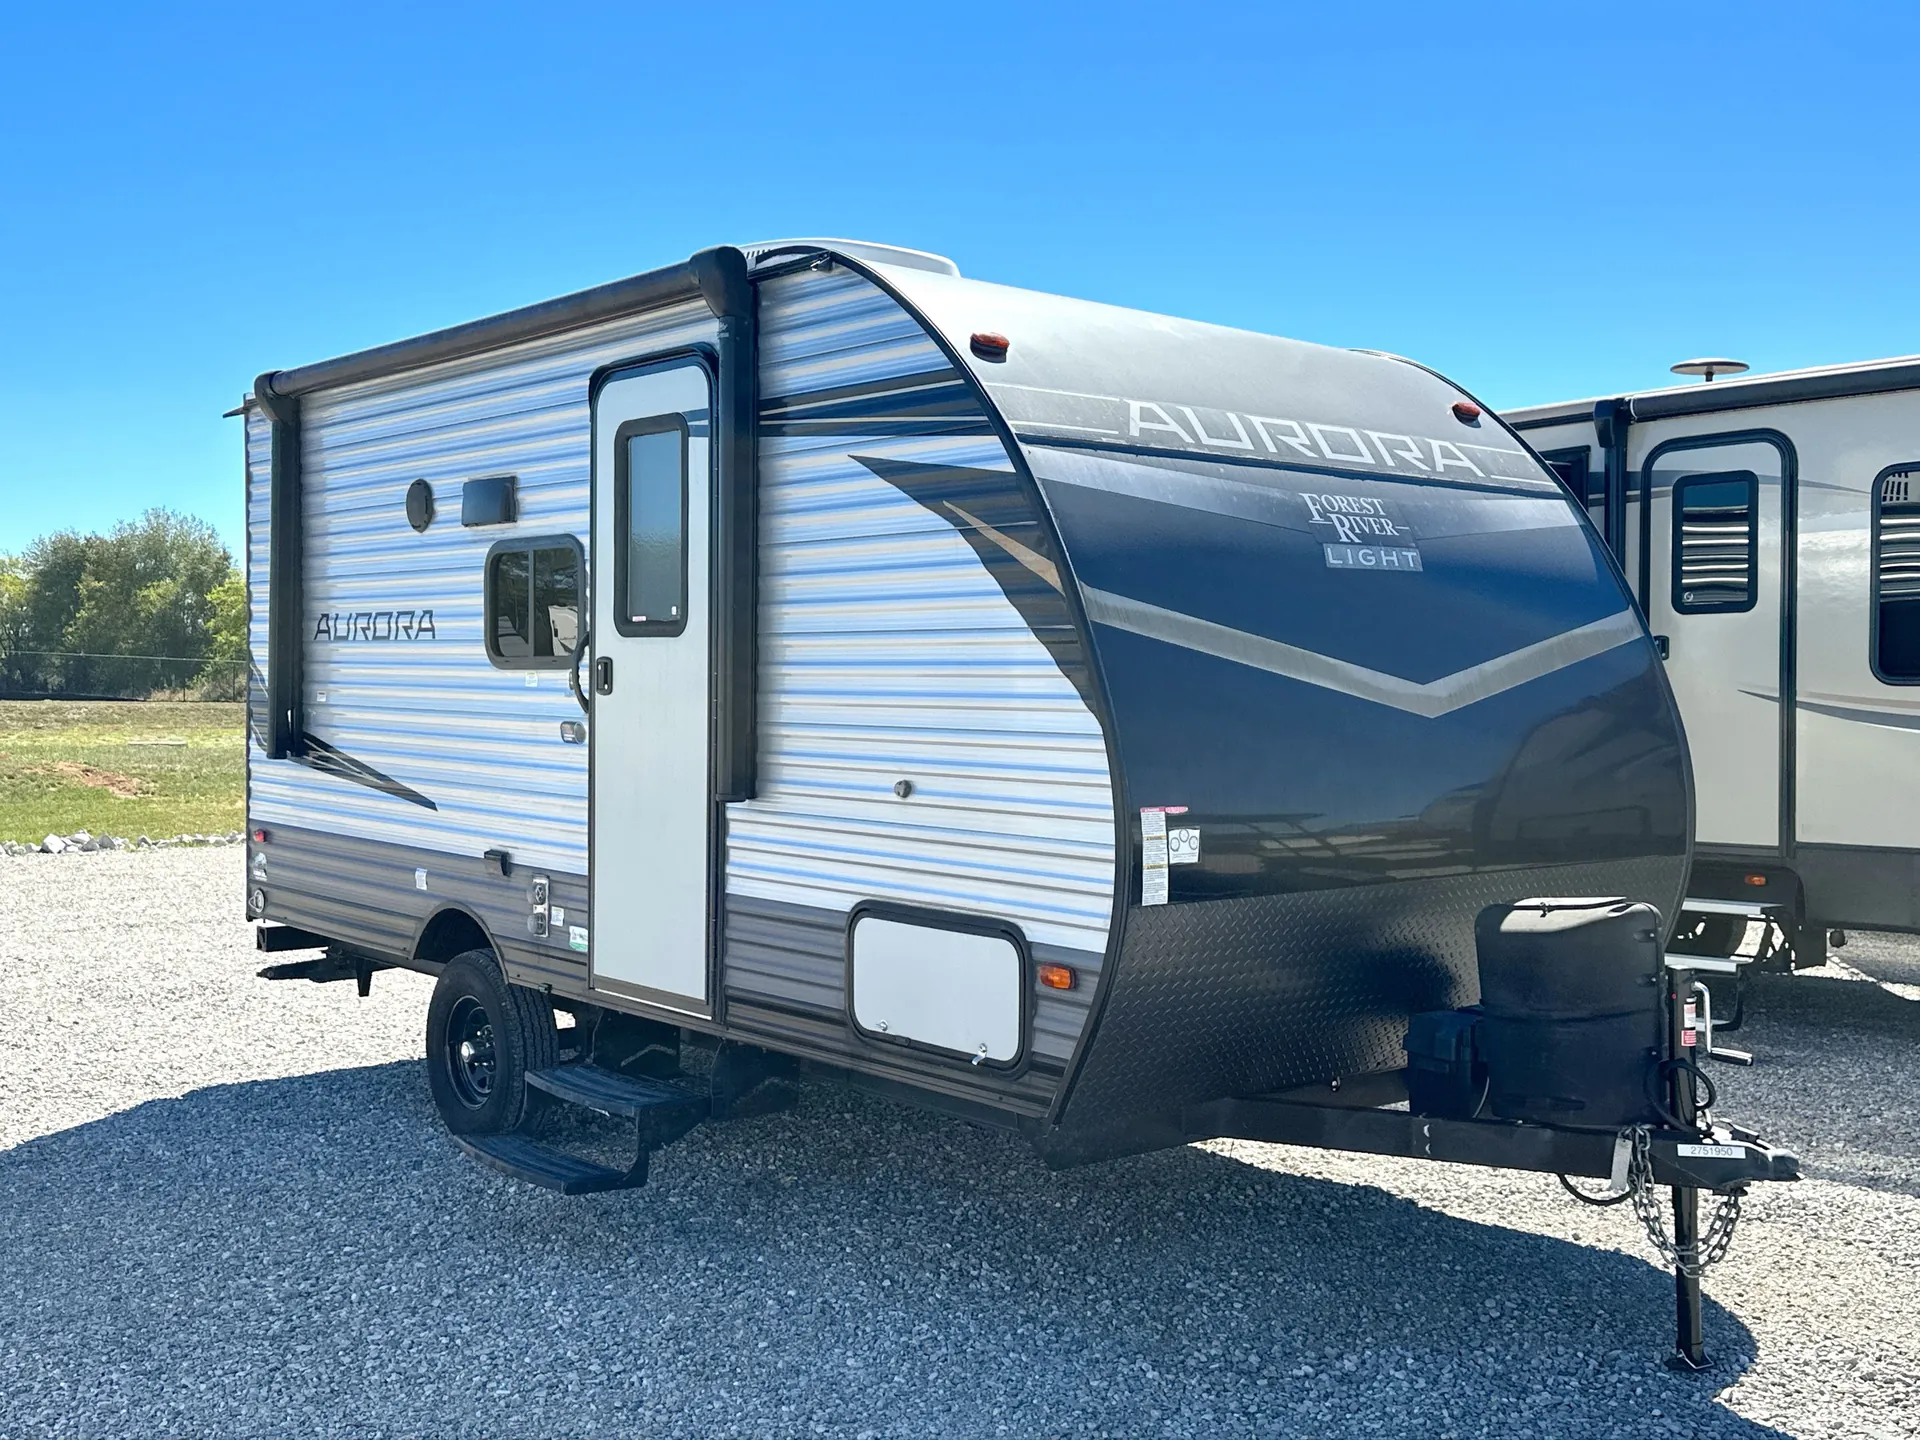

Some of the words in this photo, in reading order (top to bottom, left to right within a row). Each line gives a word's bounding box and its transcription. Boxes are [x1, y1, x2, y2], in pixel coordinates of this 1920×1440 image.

[1124, 399, 1486, 478] AURORA
[1298, 492, 1386, 521] FOREST
[1326, 513, 1400, 543] RIVER
[1327, 547, 1417, 568] LIGHT
[313, 609, 436, 641] AURORA
[1690, 1146, 1733, 1157] 2751950
